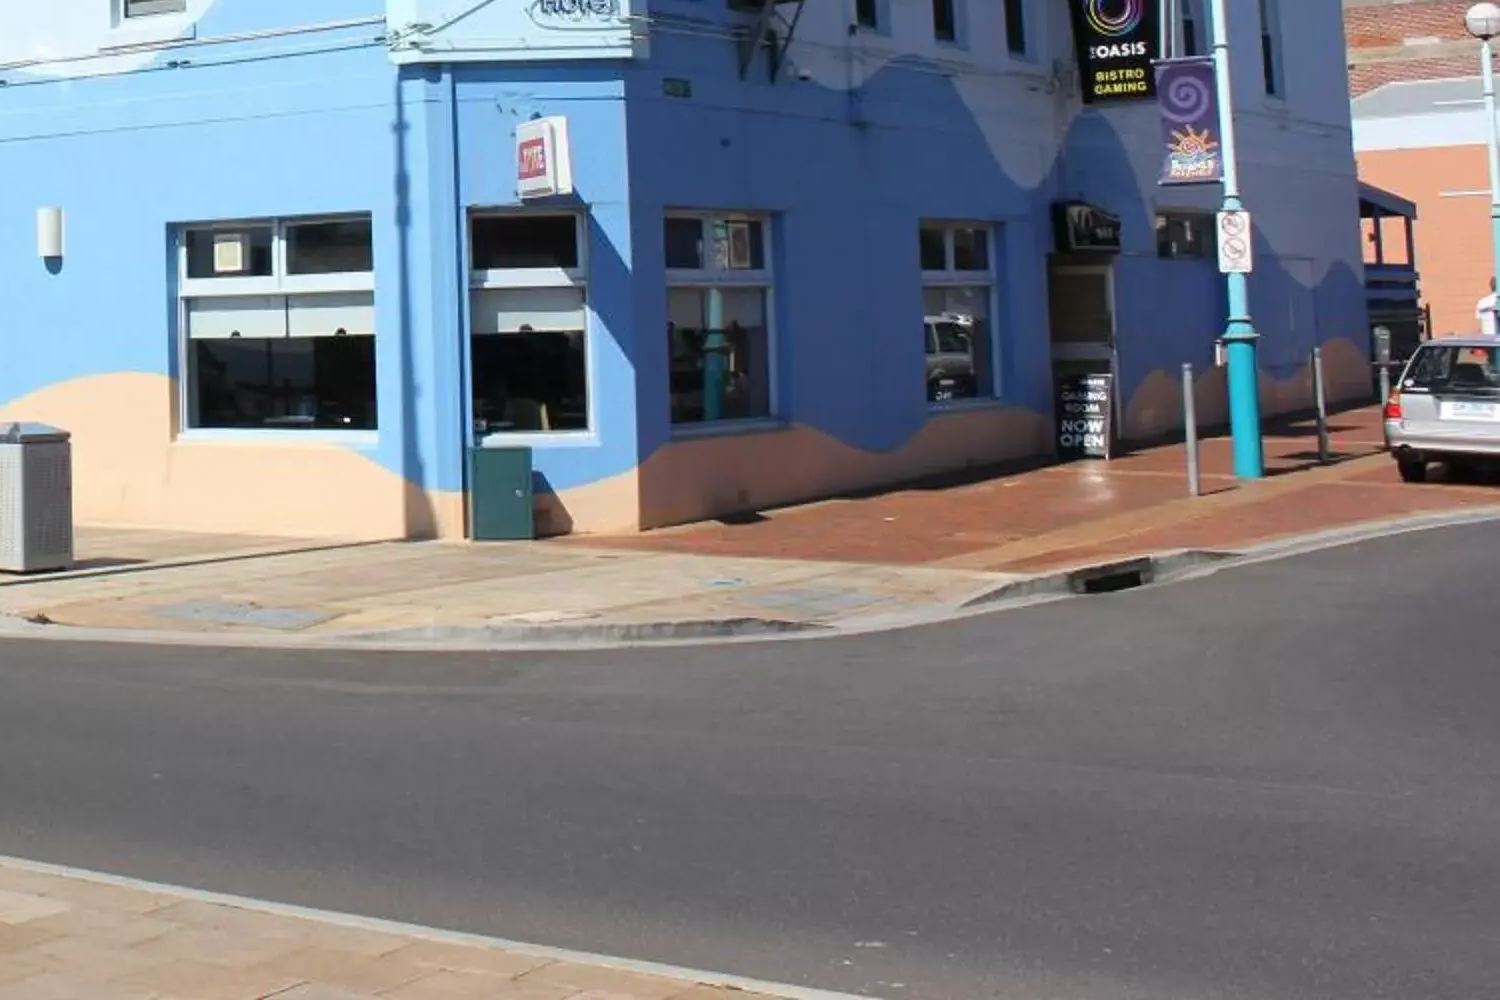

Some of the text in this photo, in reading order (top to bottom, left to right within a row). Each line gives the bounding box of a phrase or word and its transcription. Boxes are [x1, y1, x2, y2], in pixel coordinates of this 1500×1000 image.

[1096, 41, 1147, 59] OASIS
[1095, 67, 1145, 82] BISTRO
[1094, 81, 1148, 95] GAMING
[1061, 420, 1104, 433] NOW
[1060, 433, 1105, 447] OPEN
